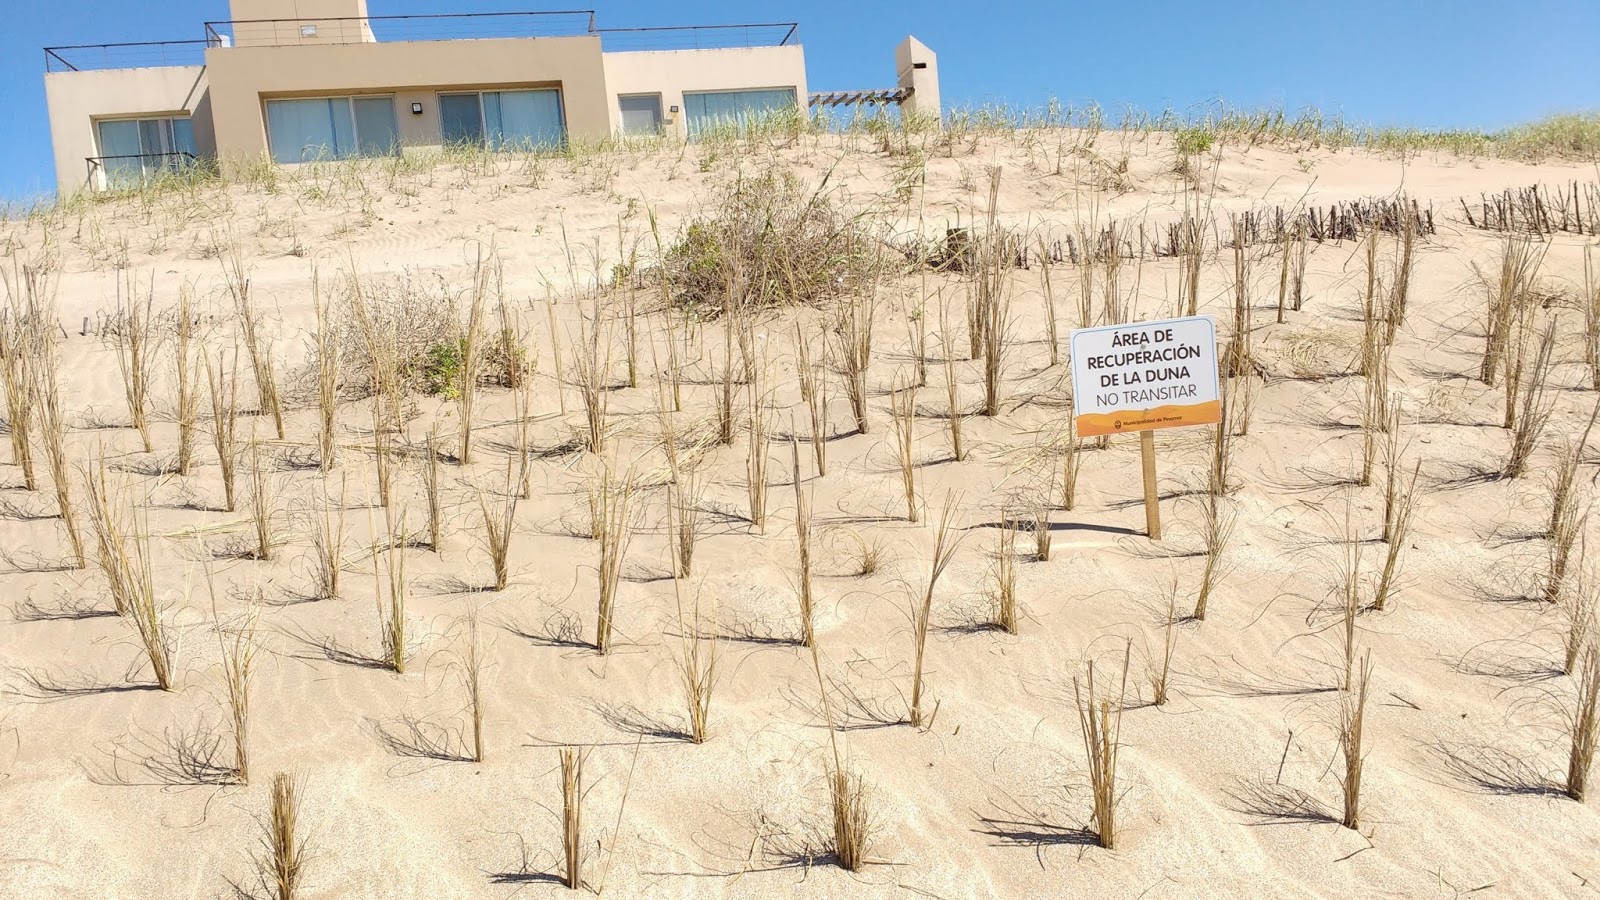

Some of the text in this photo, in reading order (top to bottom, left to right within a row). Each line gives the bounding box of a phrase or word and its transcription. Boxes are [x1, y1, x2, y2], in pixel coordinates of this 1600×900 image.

[1111, 329, 1173, 348] ÁREA DE
[1087, 343, 1201, 370] RECUPERACIÓN
[1100, 365, 1191, 388] DE LA DUNA
[1096, 384, 1197, 407] NO TRANSITAR
[1123, 418, 1156, 426] Municipalidad
